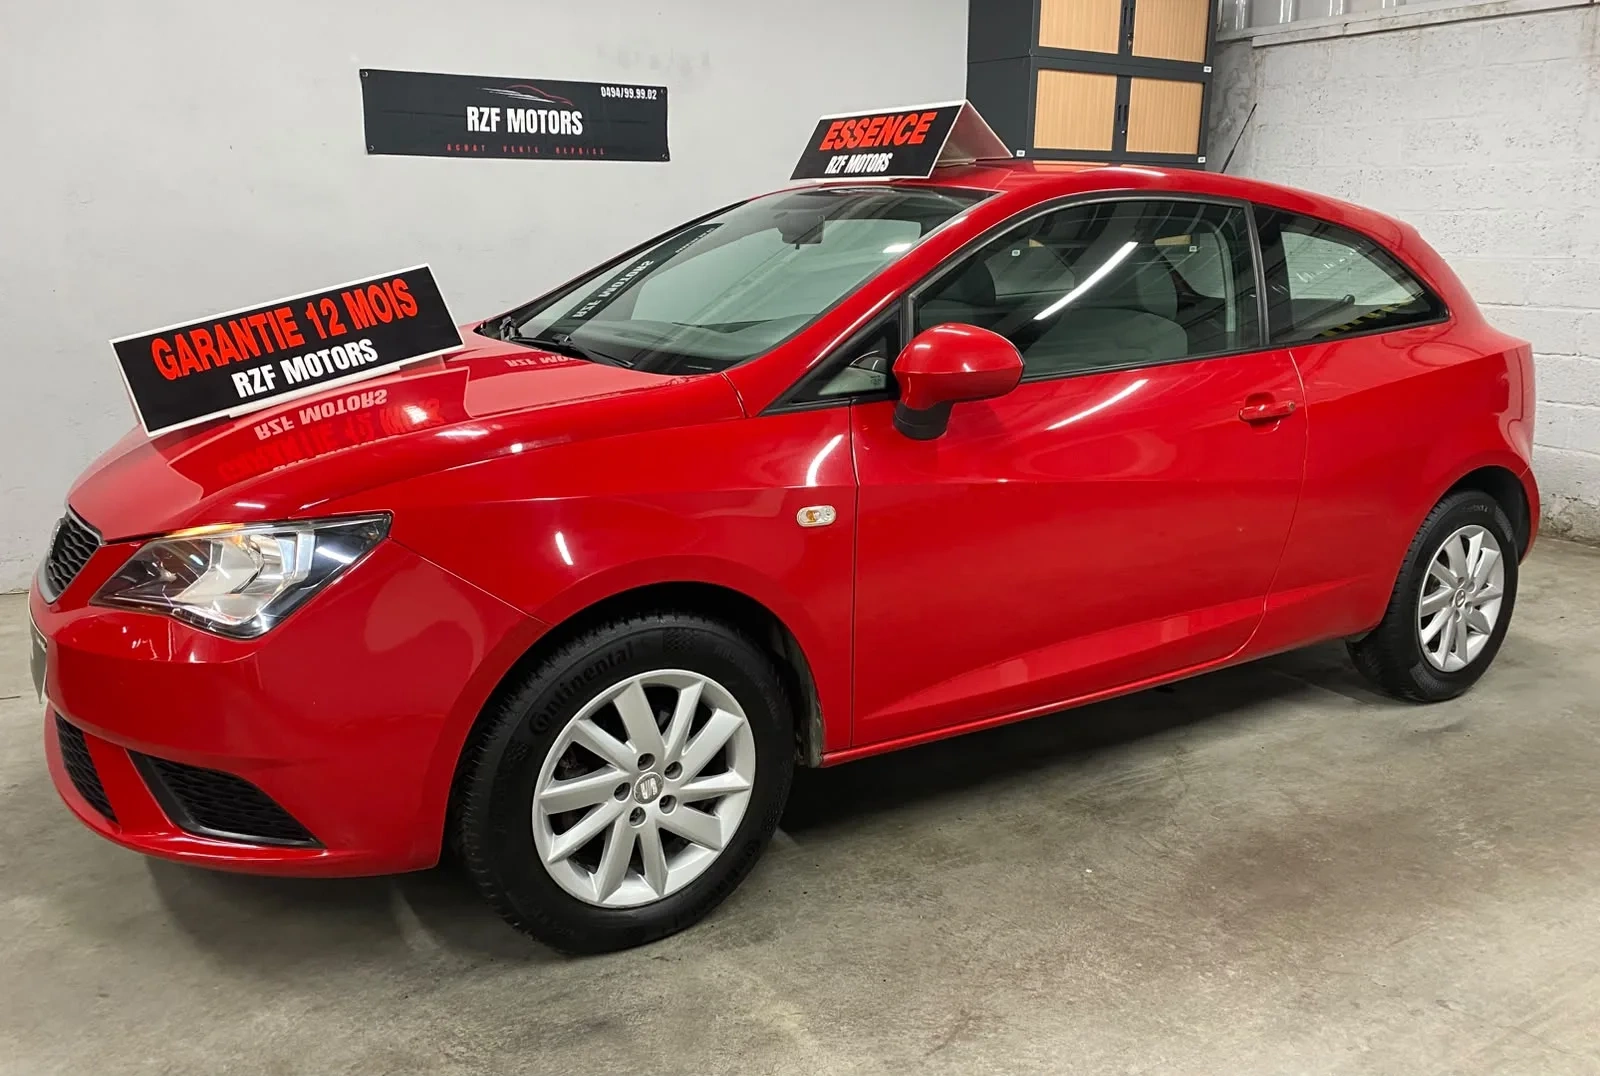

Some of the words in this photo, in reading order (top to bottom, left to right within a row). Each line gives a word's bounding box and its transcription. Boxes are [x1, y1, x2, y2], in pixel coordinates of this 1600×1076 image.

[600, 86, 657, 100] 0494/99.99.02
[466, 106, 501, 132] RZF
[506, 107, 584, 136] MOTORS
[819, 111, 938, 151] ESSENCE
[824, 154, 848, 174] RZF
[844, 152, 894, 174] MOTORS
[152, 306, 304, 380] GARANTIE
[305, 298, 346, 340] 12
[341, 278, 419, 331] MOIS
[231, 366, 277, 399] RZF
[281, 338, 379, 385] MOTORS
[529, 641, 634, 735] Continental
